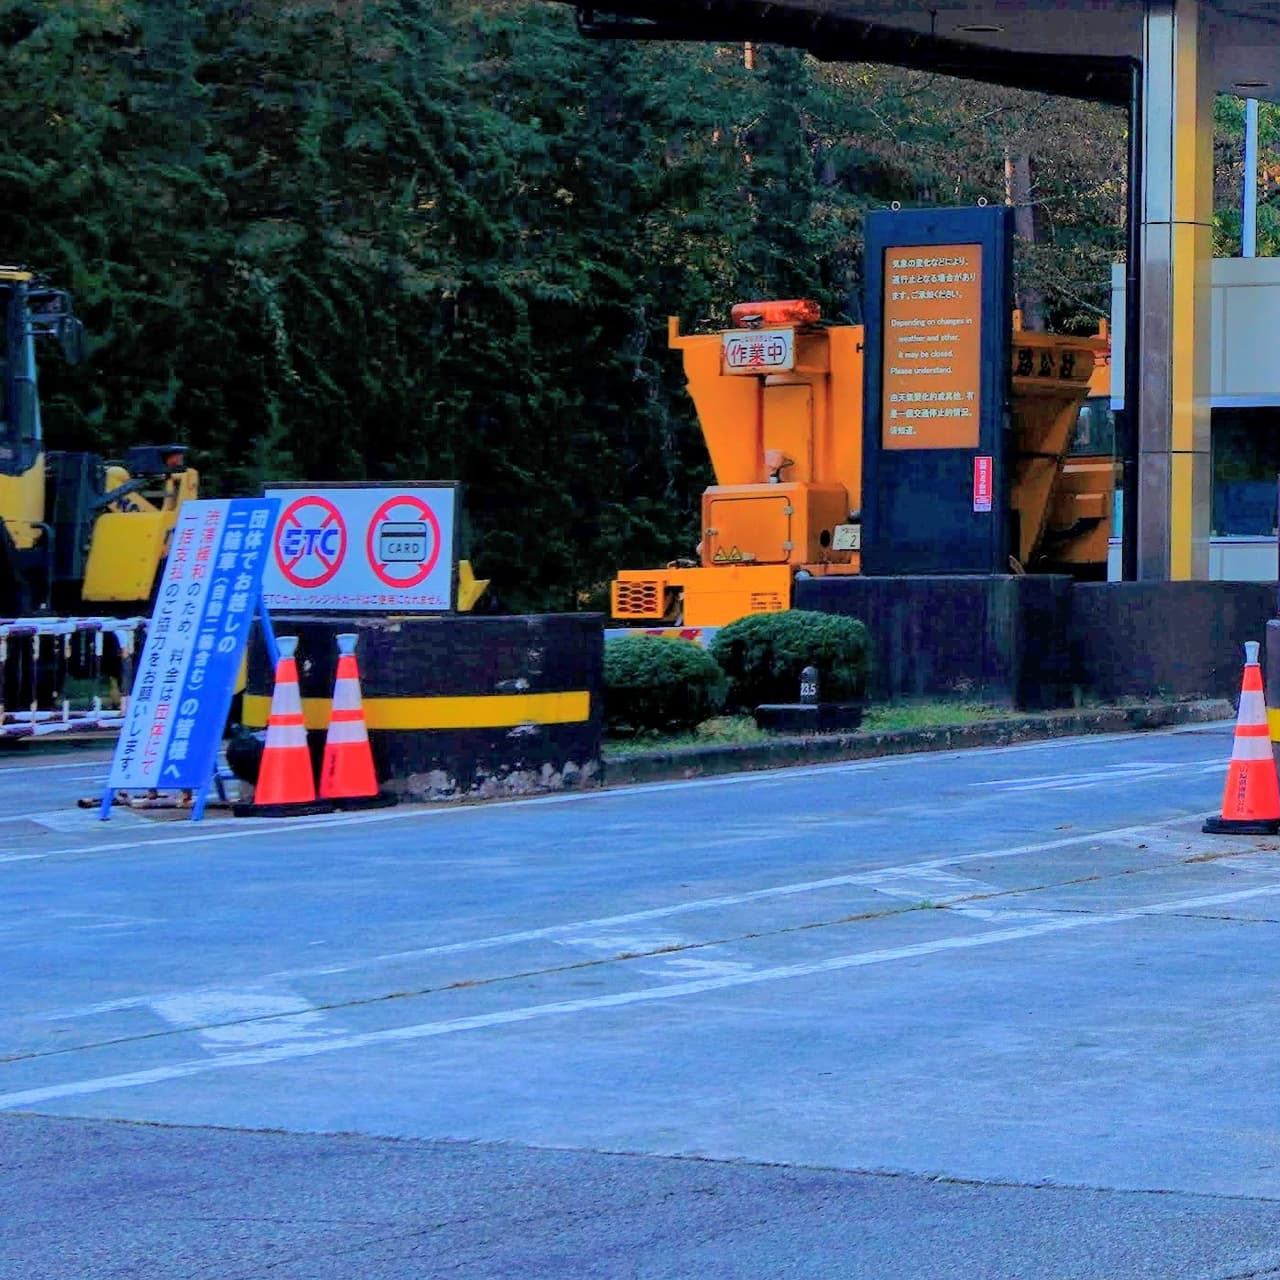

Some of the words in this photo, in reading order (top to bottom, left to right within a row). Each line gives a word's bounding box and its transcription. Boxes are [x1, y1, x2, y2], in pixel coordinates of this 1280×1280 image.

[731, 342, 782, 364] 作業中
[282, 528, 339, 557] ETC
[388, 542, 420, 555] CARD
